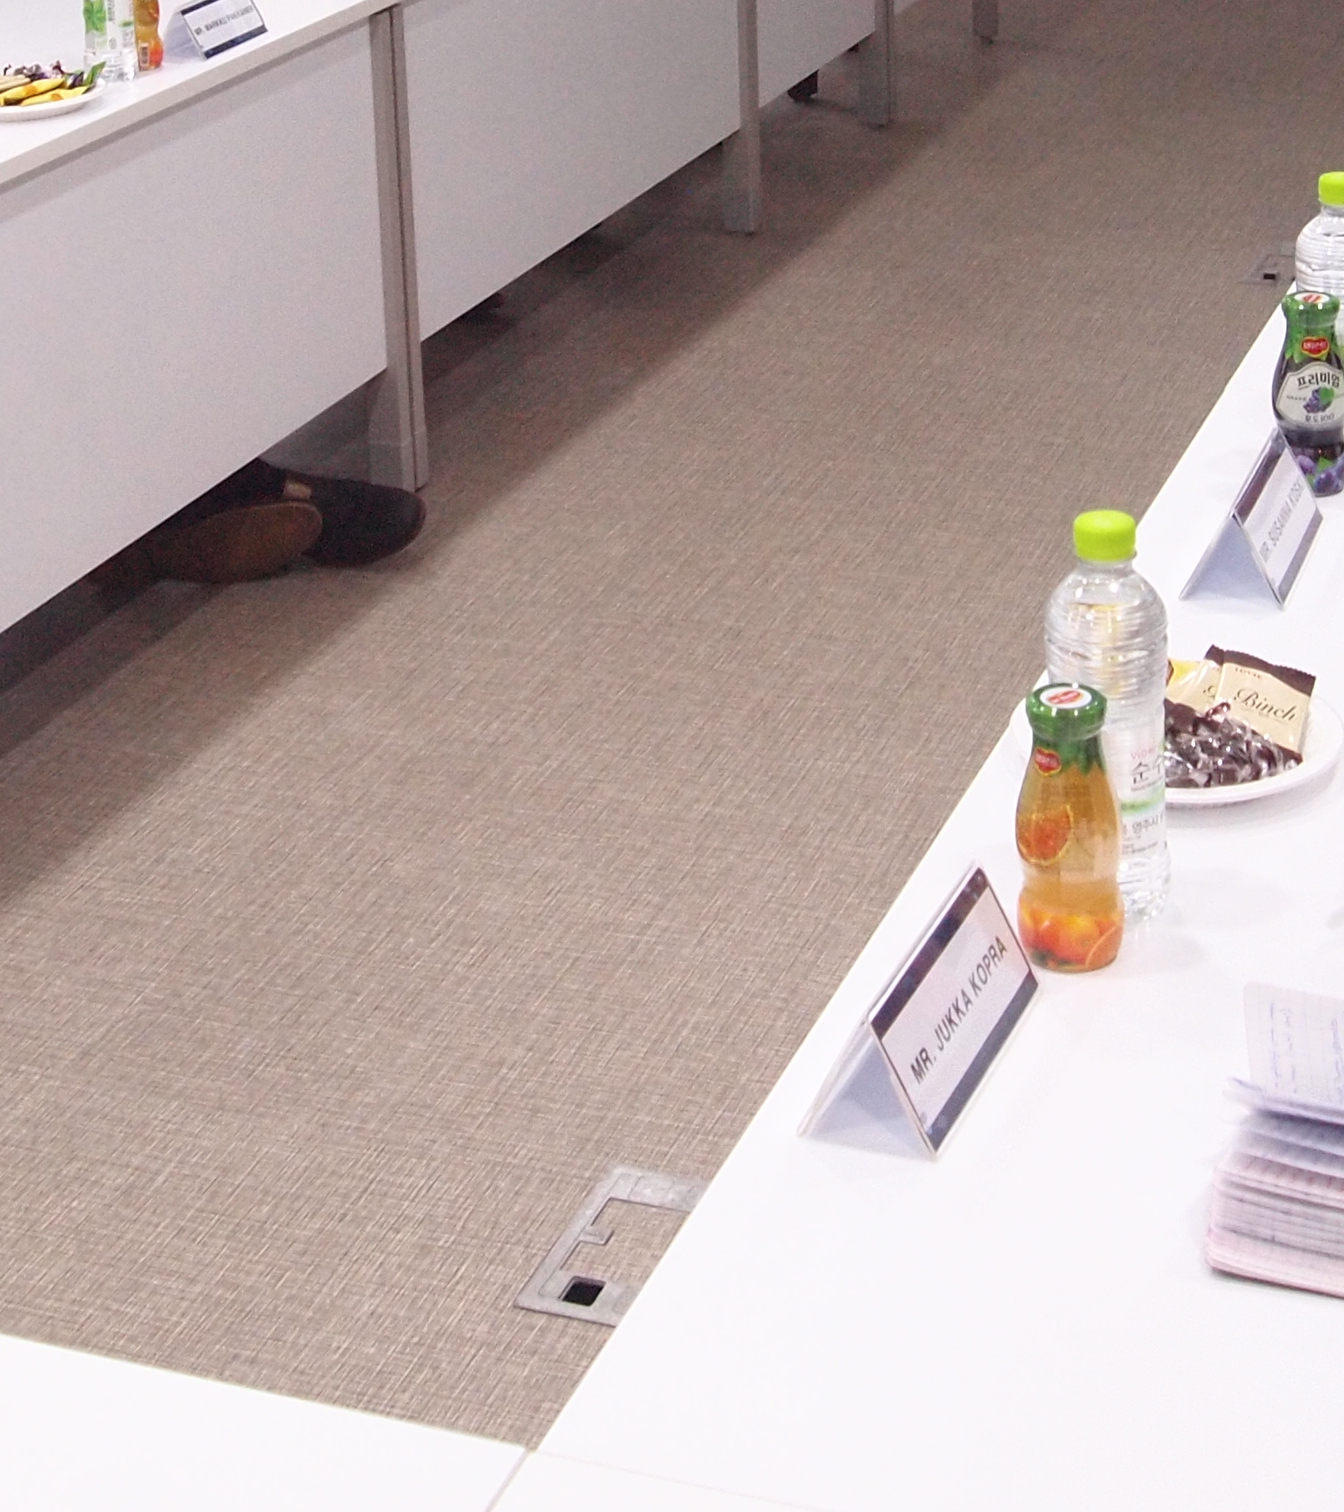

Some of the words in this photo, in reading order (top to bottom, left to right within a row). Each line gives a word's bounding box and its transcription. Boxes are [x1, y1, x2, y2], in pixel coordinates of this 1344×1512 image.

[1233, 687, 1297, 721] Binch
[910, 1046, 937, 1086] MR.
[933, 988, 974, 1051] JUKKA
[969, 935, 1008, 997] KOPRA
